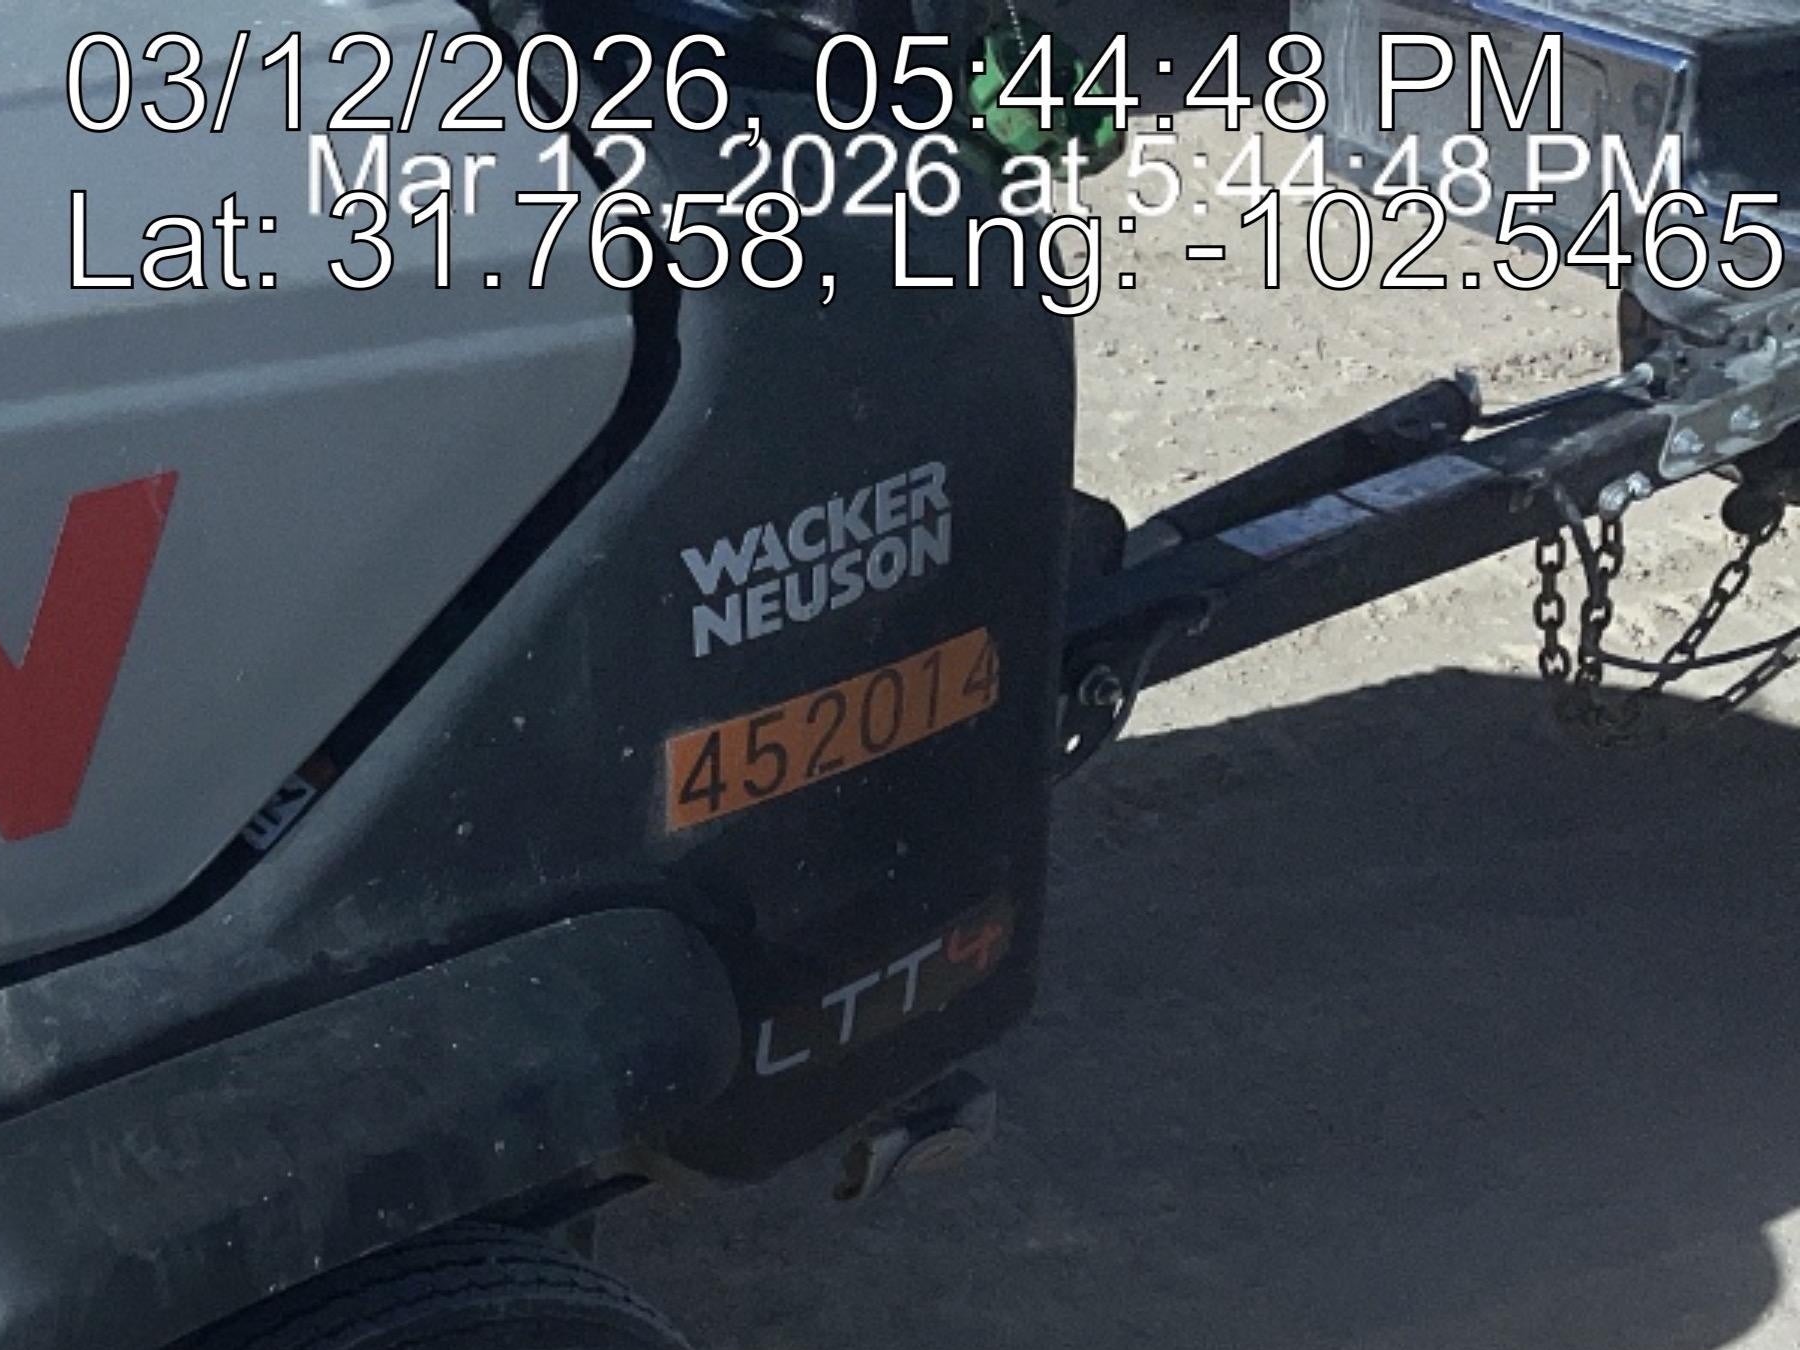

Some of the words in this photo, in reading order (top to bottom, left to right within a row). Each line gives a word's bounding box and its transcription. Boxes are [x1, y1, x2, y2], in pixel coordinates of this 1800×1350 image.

[680, 460, 951, 596] WACKER
[691, 512, 952, 658] NEUSON
[677, 636, 1001, 814] 452014
